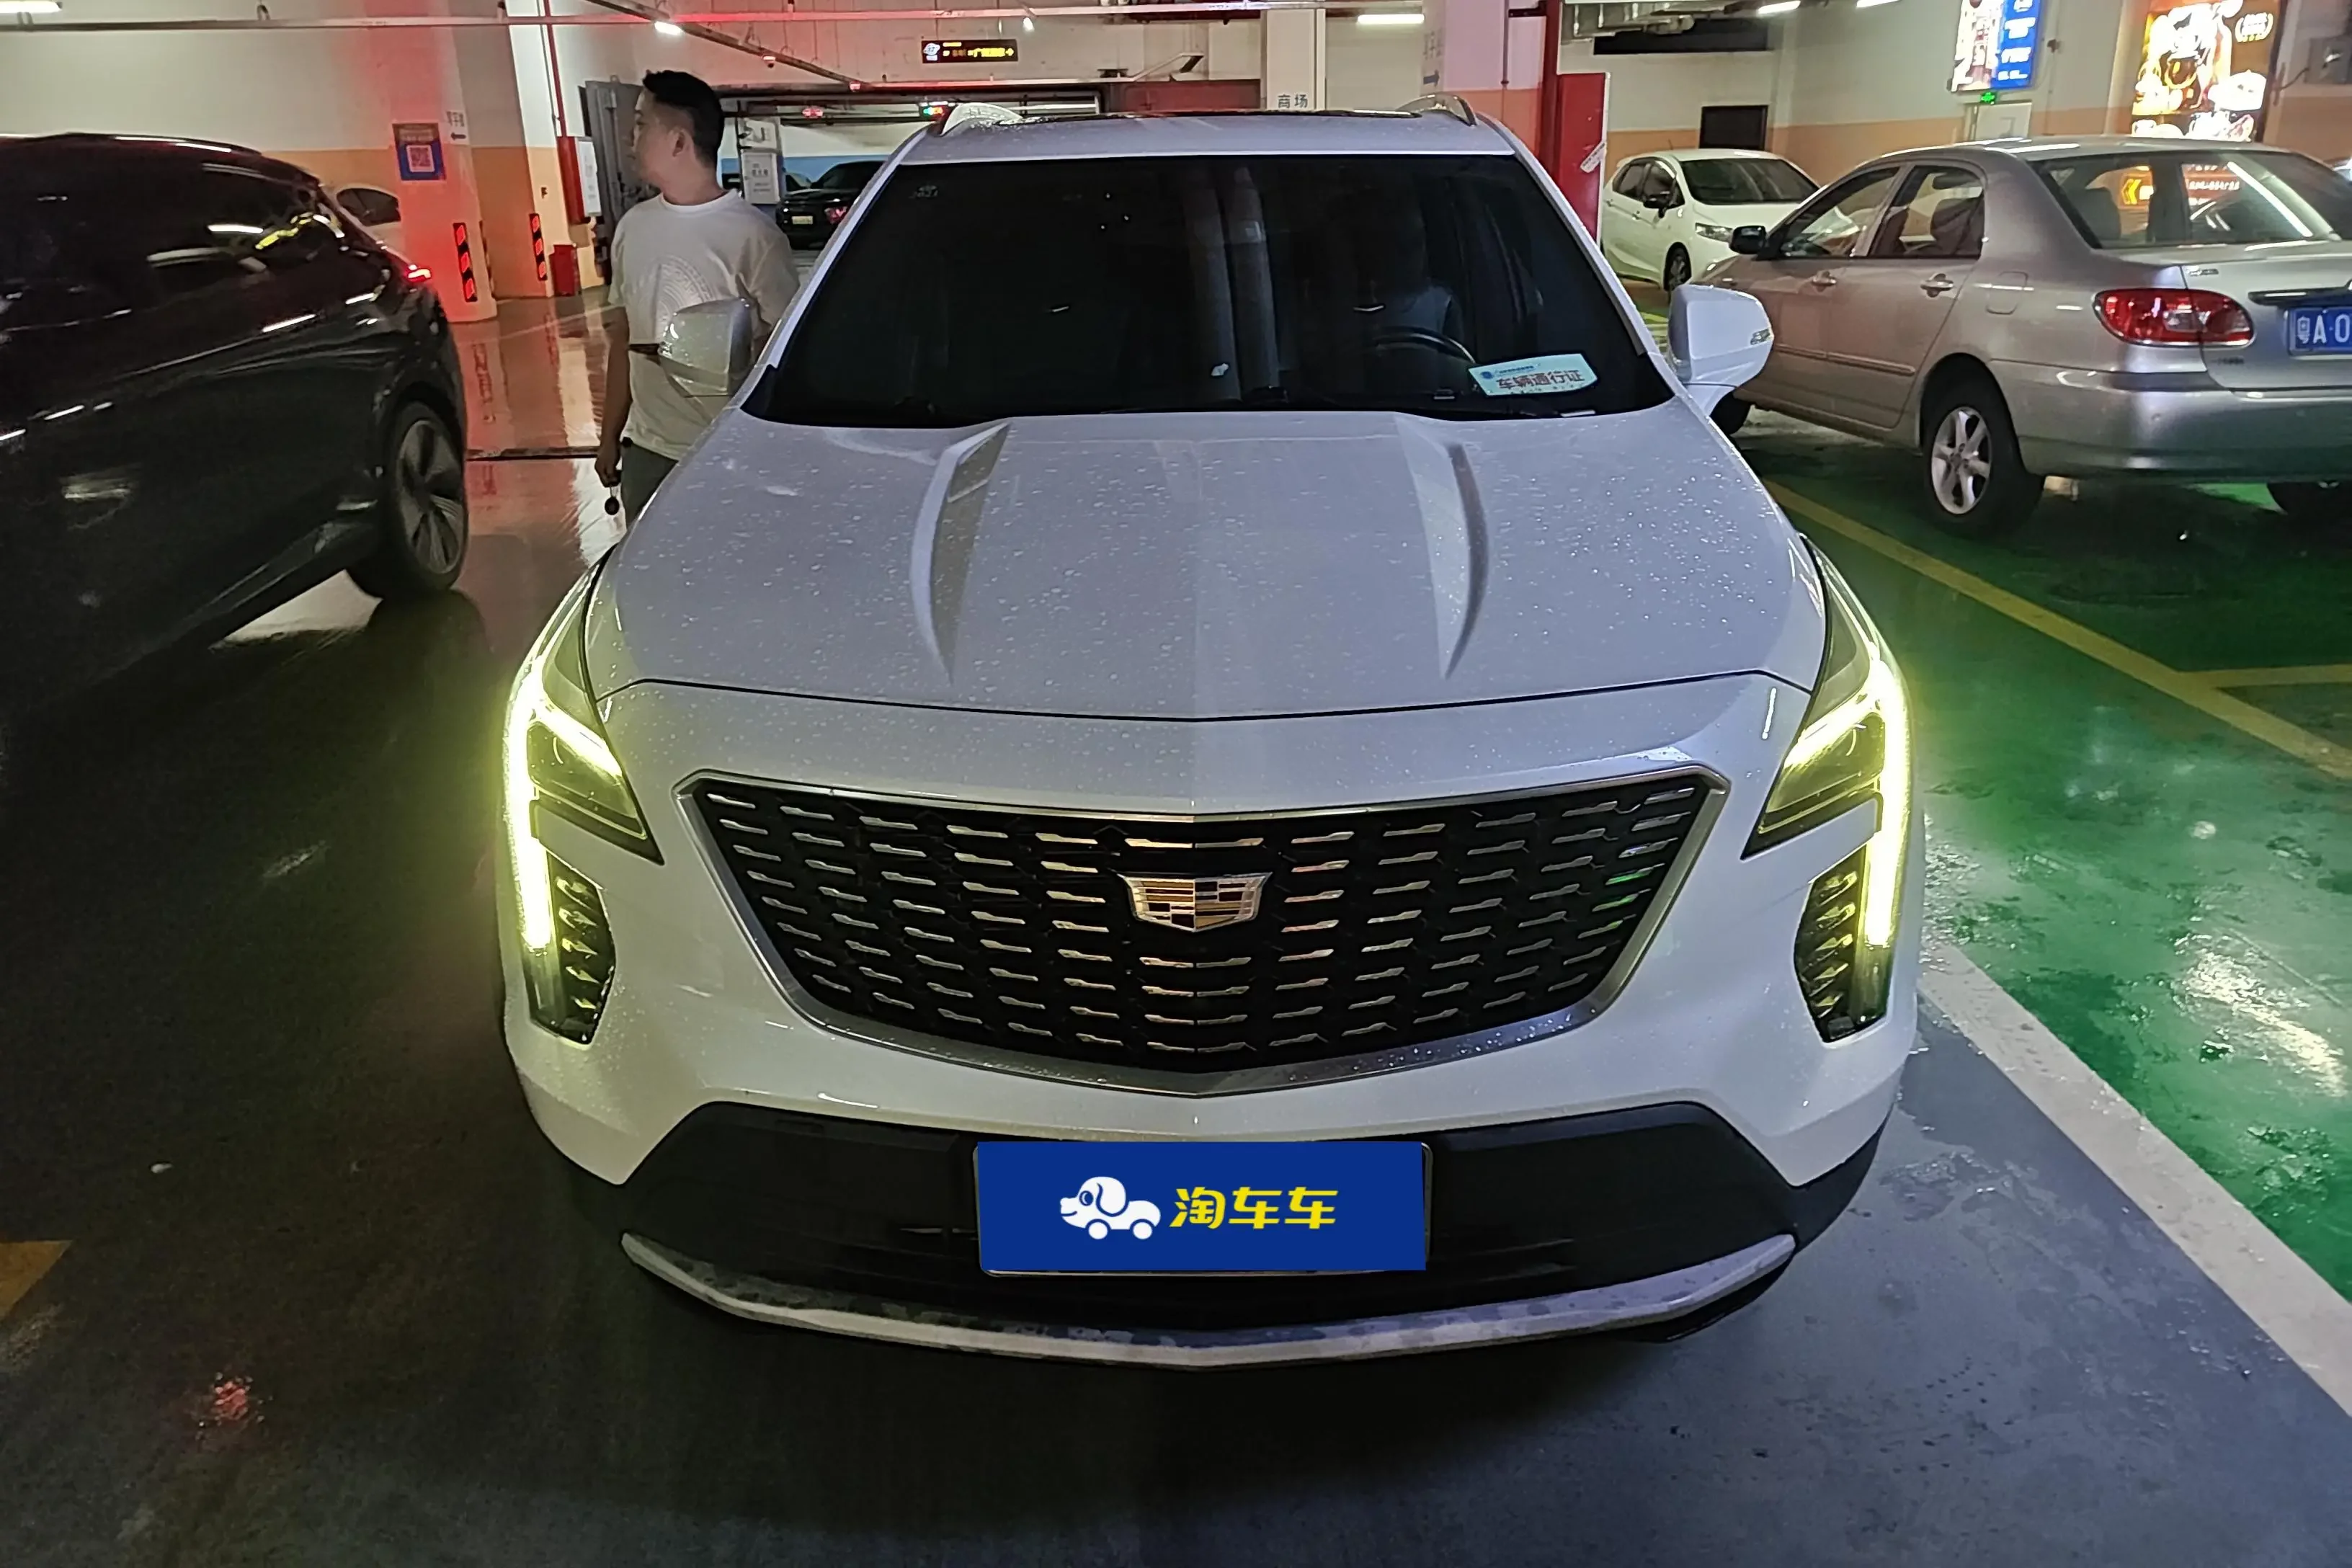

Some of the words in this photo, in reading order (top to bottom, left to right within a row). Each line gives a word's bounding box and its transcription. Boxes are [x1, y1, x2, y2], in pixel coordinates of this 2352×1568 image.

[1278, 94, 1309, 109] 商场
[1495, 369, 1585, 390] 车辆通行证
